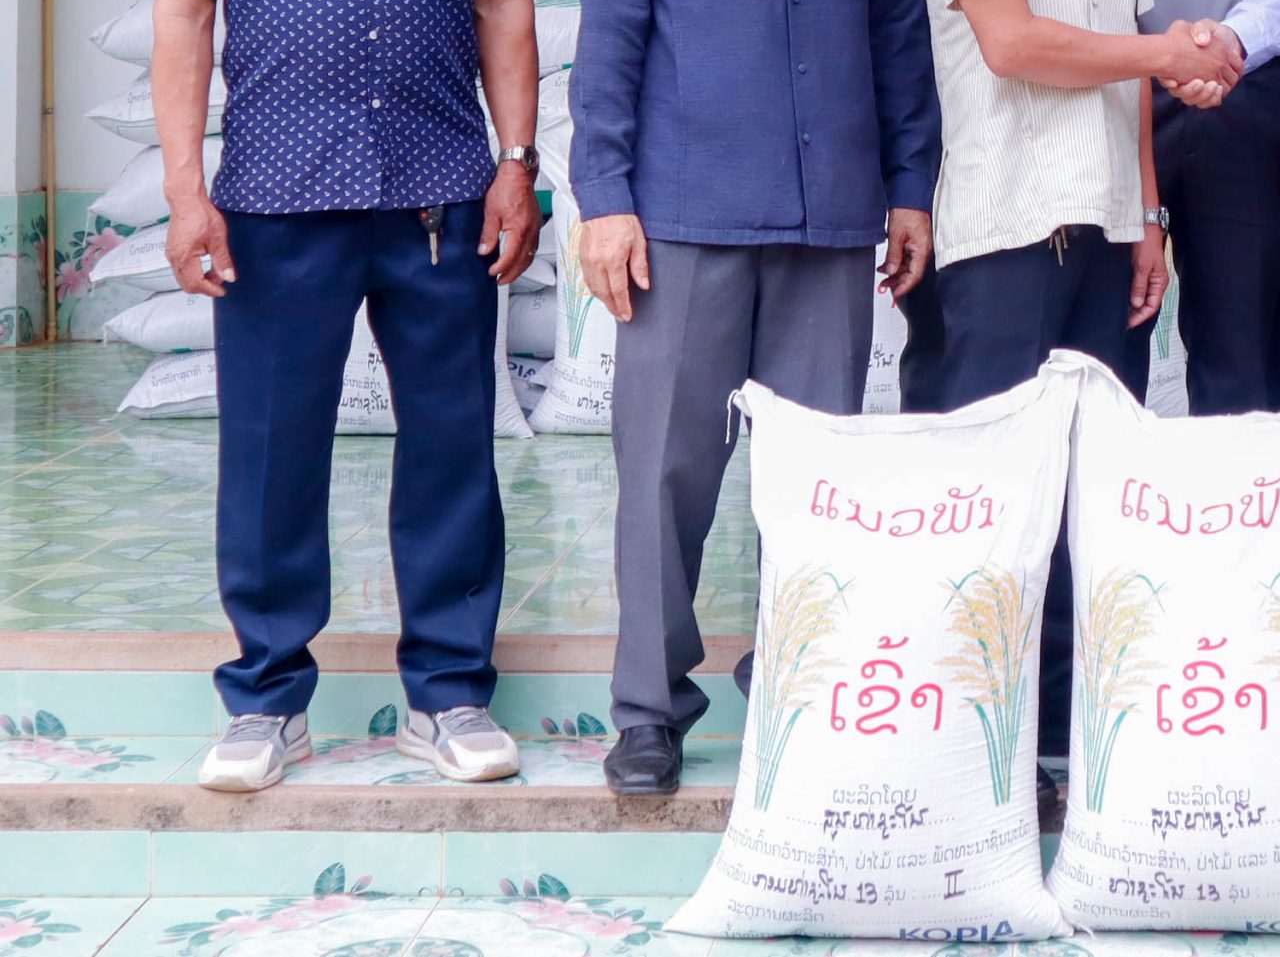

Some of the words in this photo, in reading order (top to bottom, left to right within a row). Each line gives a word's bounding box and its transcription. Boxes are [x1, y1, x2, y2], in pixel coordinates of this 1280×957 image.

[830, 636, 943, 735] ເຂົ້າ
[1156, 637, 1268, 736] ເຂົ້າ
[896, 854, 927, 869] ແລະ
[1237, 854, 1268, 869] ແລະ
[856, 882, 878, 905] 13
[1196, 884, 1220, 901] 13
[899, 920, 1014, 942] KOPIA
